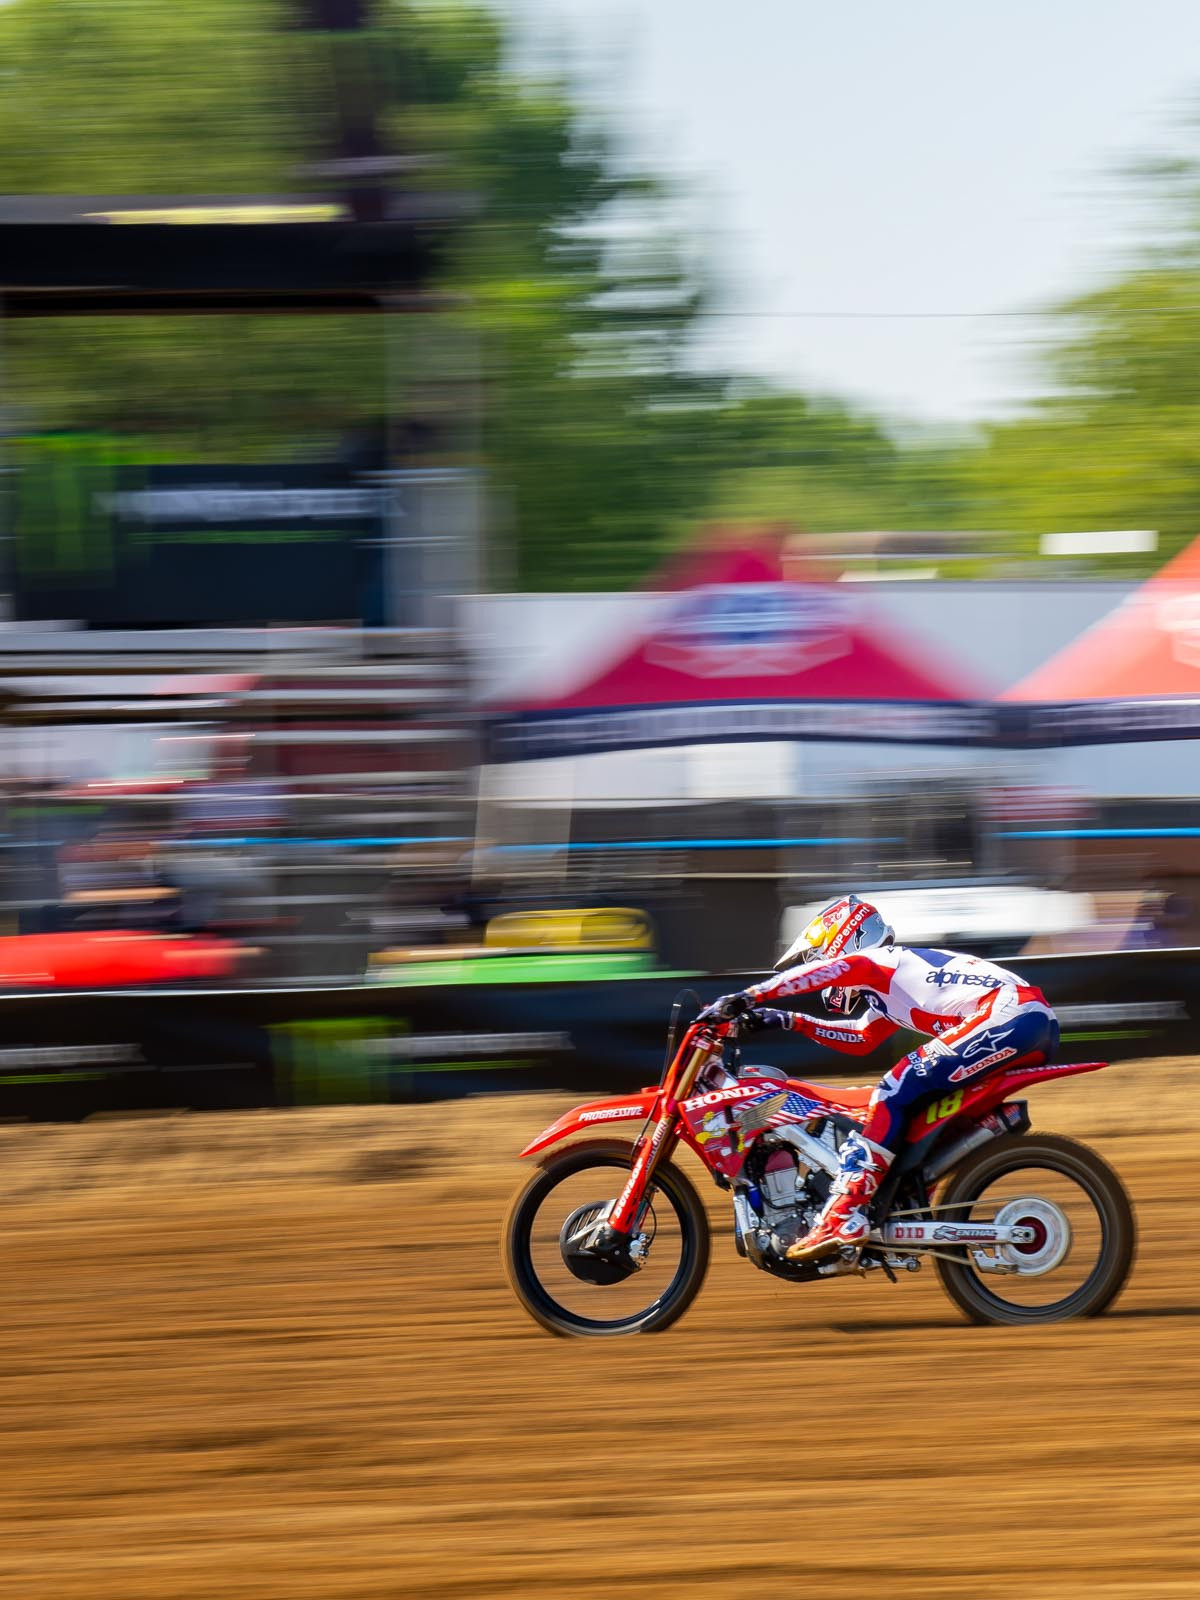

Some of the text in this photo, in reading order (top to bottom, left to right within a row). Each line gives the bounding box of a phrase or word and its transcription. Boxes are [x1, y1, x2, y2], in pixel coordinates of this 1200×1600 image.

[815, 1027, 866, 1043] HONDA
[965, 1048, 1014, 1075] HONDA
[684, 1082, 782, 1113] HONDA
[926, 1089, 964, 1125] 18
[578, 1105, 644, 1122] PROGRESSIVE
[612, 1156, 644, 1219] DUNLOP
